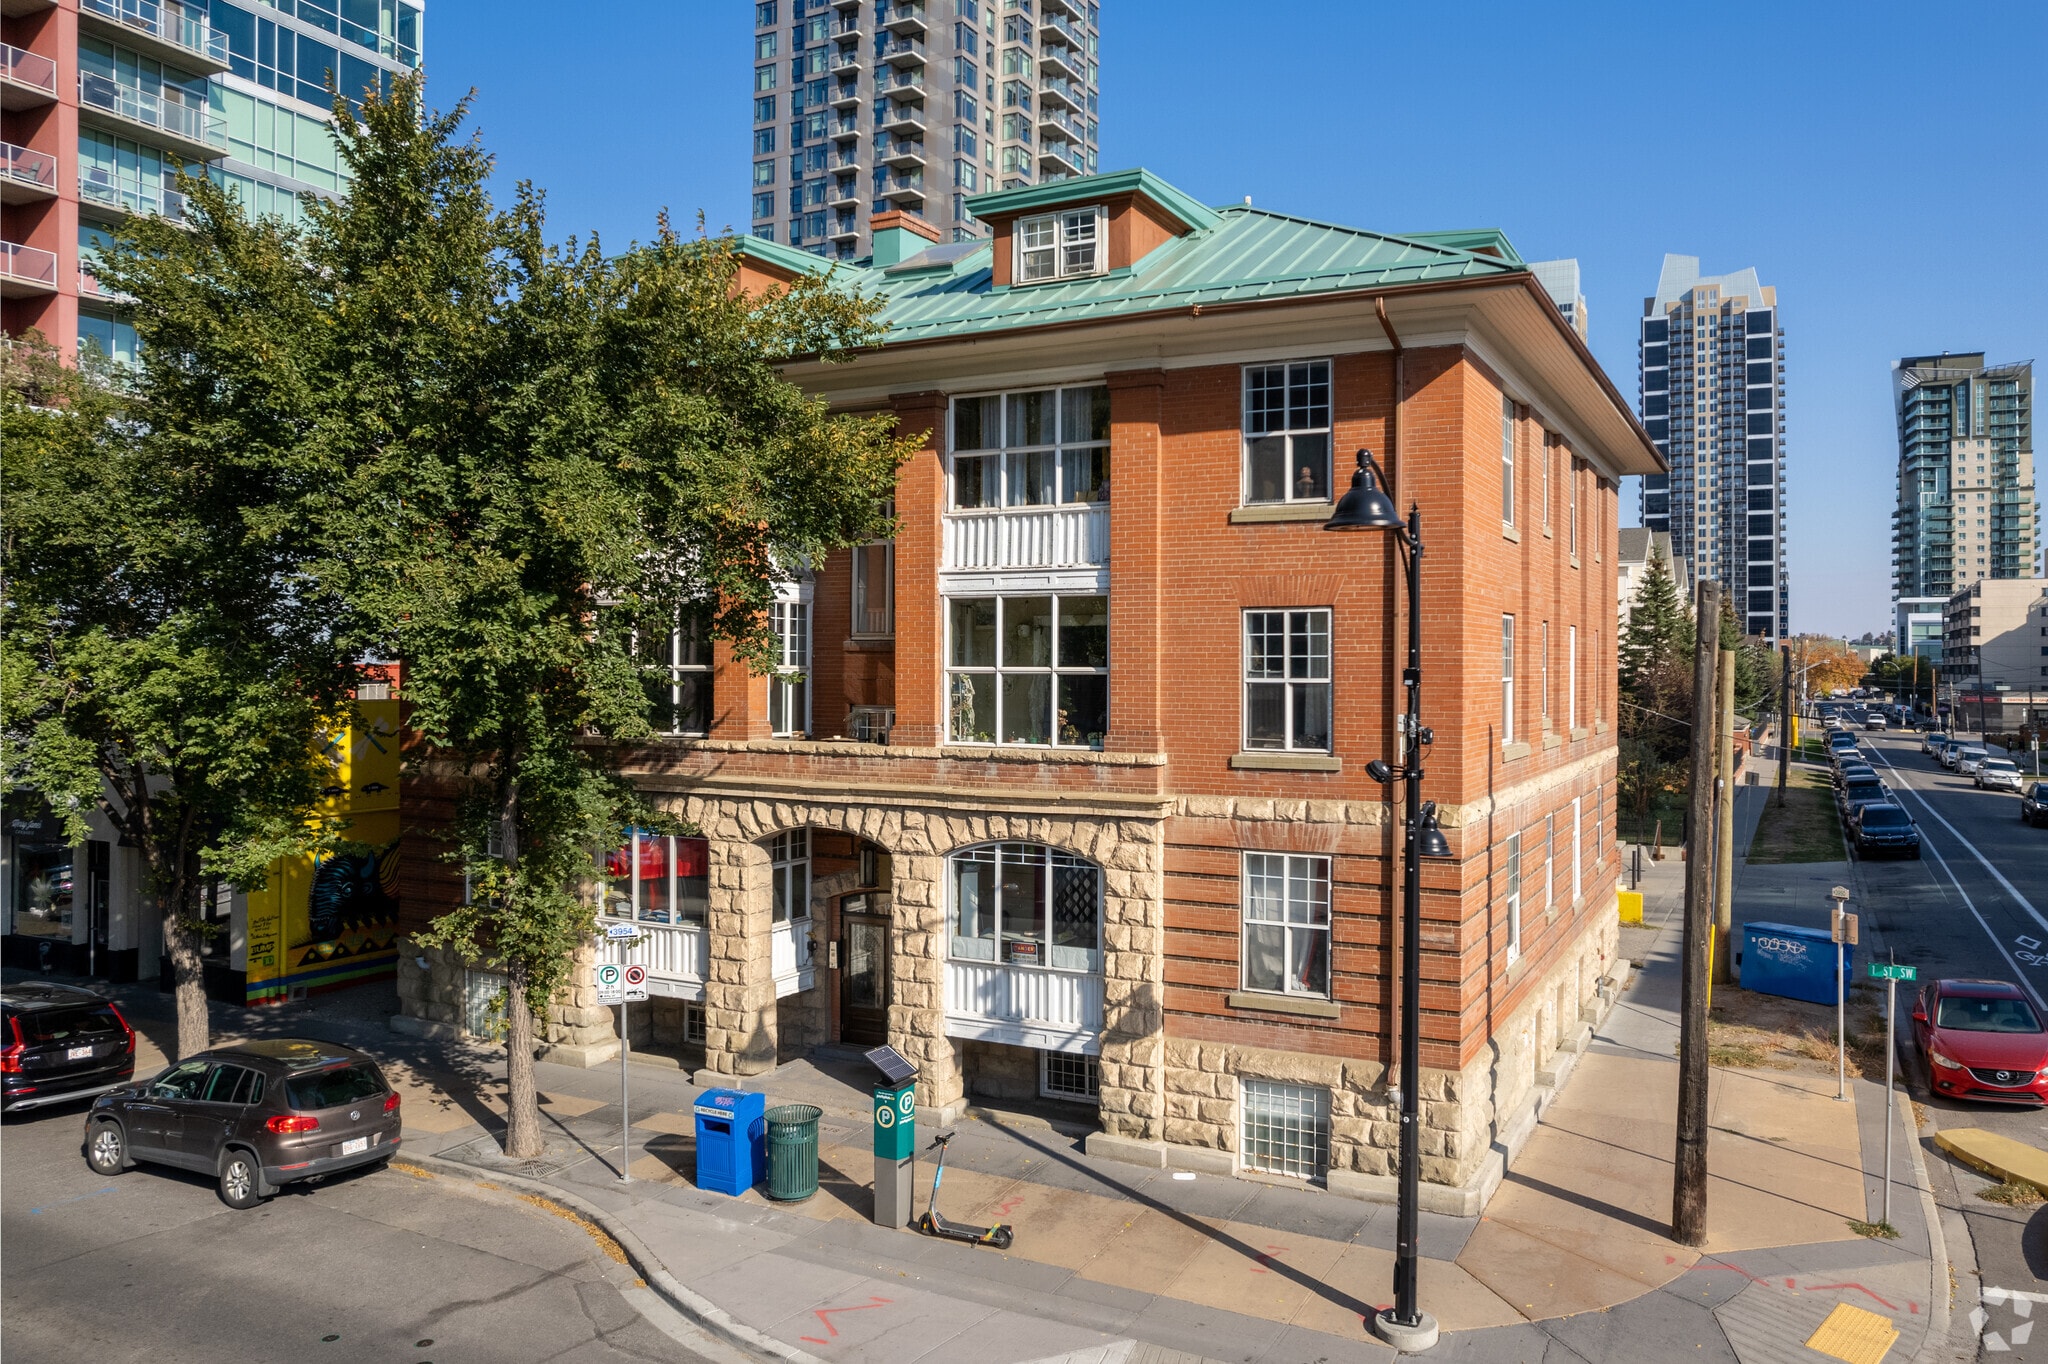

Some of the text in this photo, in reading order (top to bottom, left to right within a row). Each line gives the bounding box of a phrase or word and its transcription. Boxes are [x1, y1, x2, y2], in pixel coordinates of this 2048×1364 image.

[613, 927, 633, 936] 3954
[1871, 965, 1914, 979] 1 ST SW
